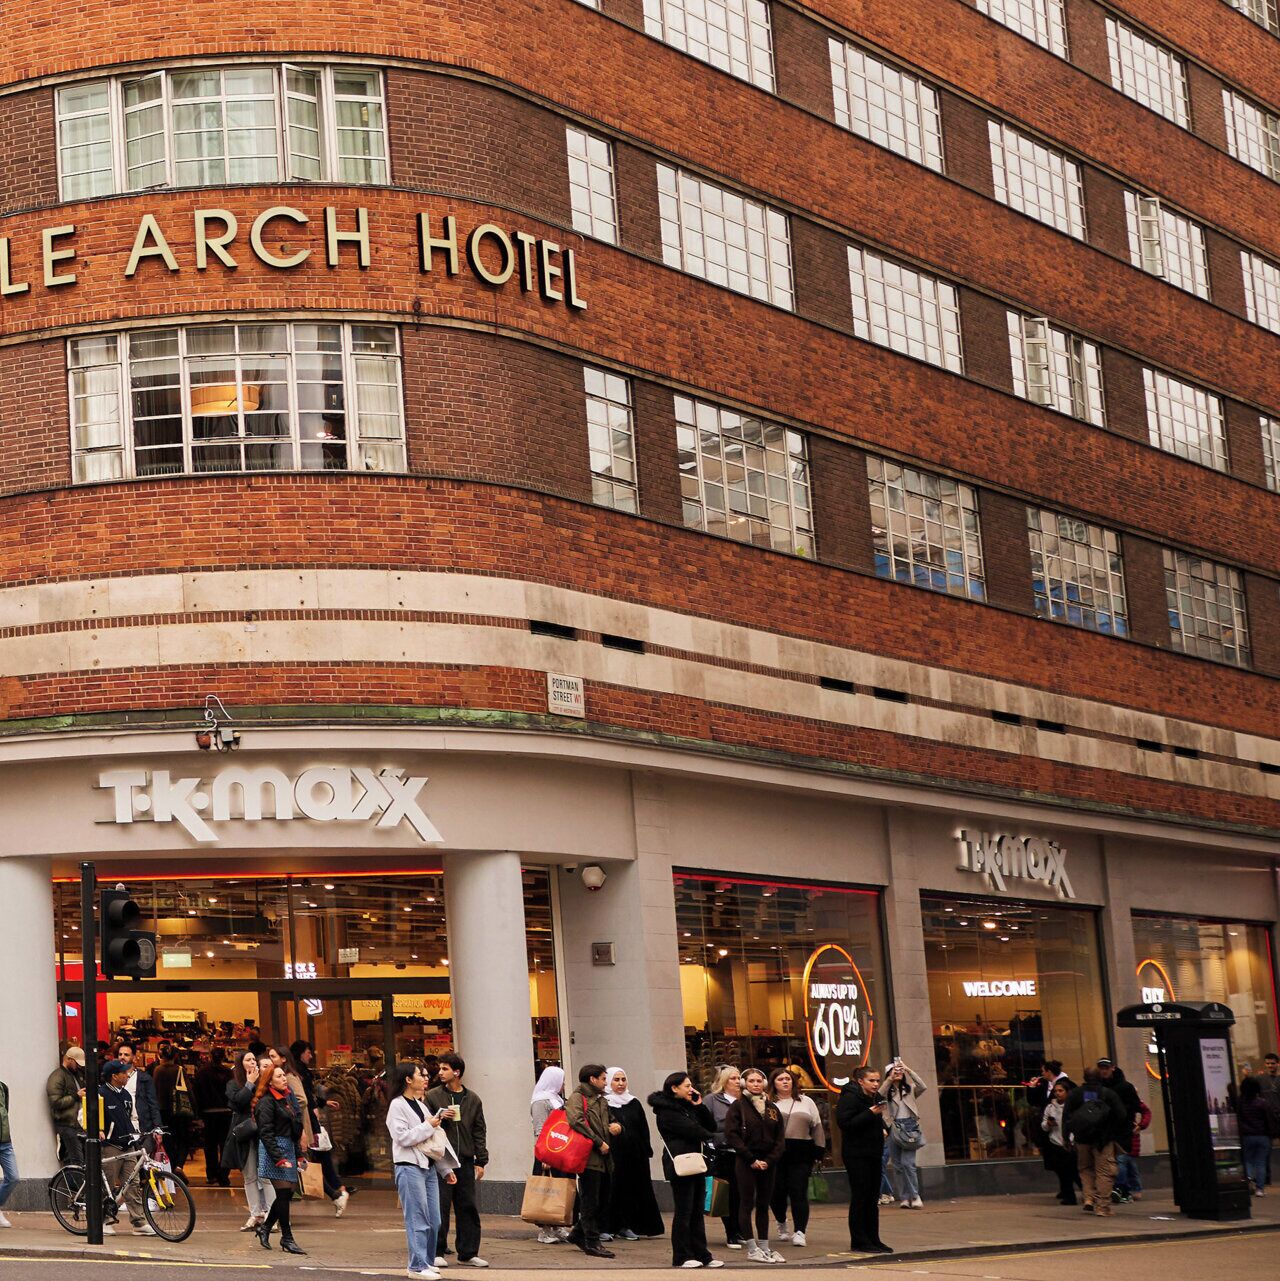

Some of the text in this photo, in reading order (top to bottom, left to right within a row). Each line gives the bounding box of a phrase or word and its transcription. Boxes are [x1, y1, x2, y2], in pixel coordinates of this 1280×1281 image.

[124, 205, 371, 277] ARCH
[416, 211, 588, 311] HOTEL
[552, 677, 579, 692] PORTMAN
[552, 691, 573, 703] STREET
[811, 983, 858, 1000] ALWAYS UP TO
[962, 979, 1037, 997] WELCOME
[814, 1002, 860, 1057] 60%
